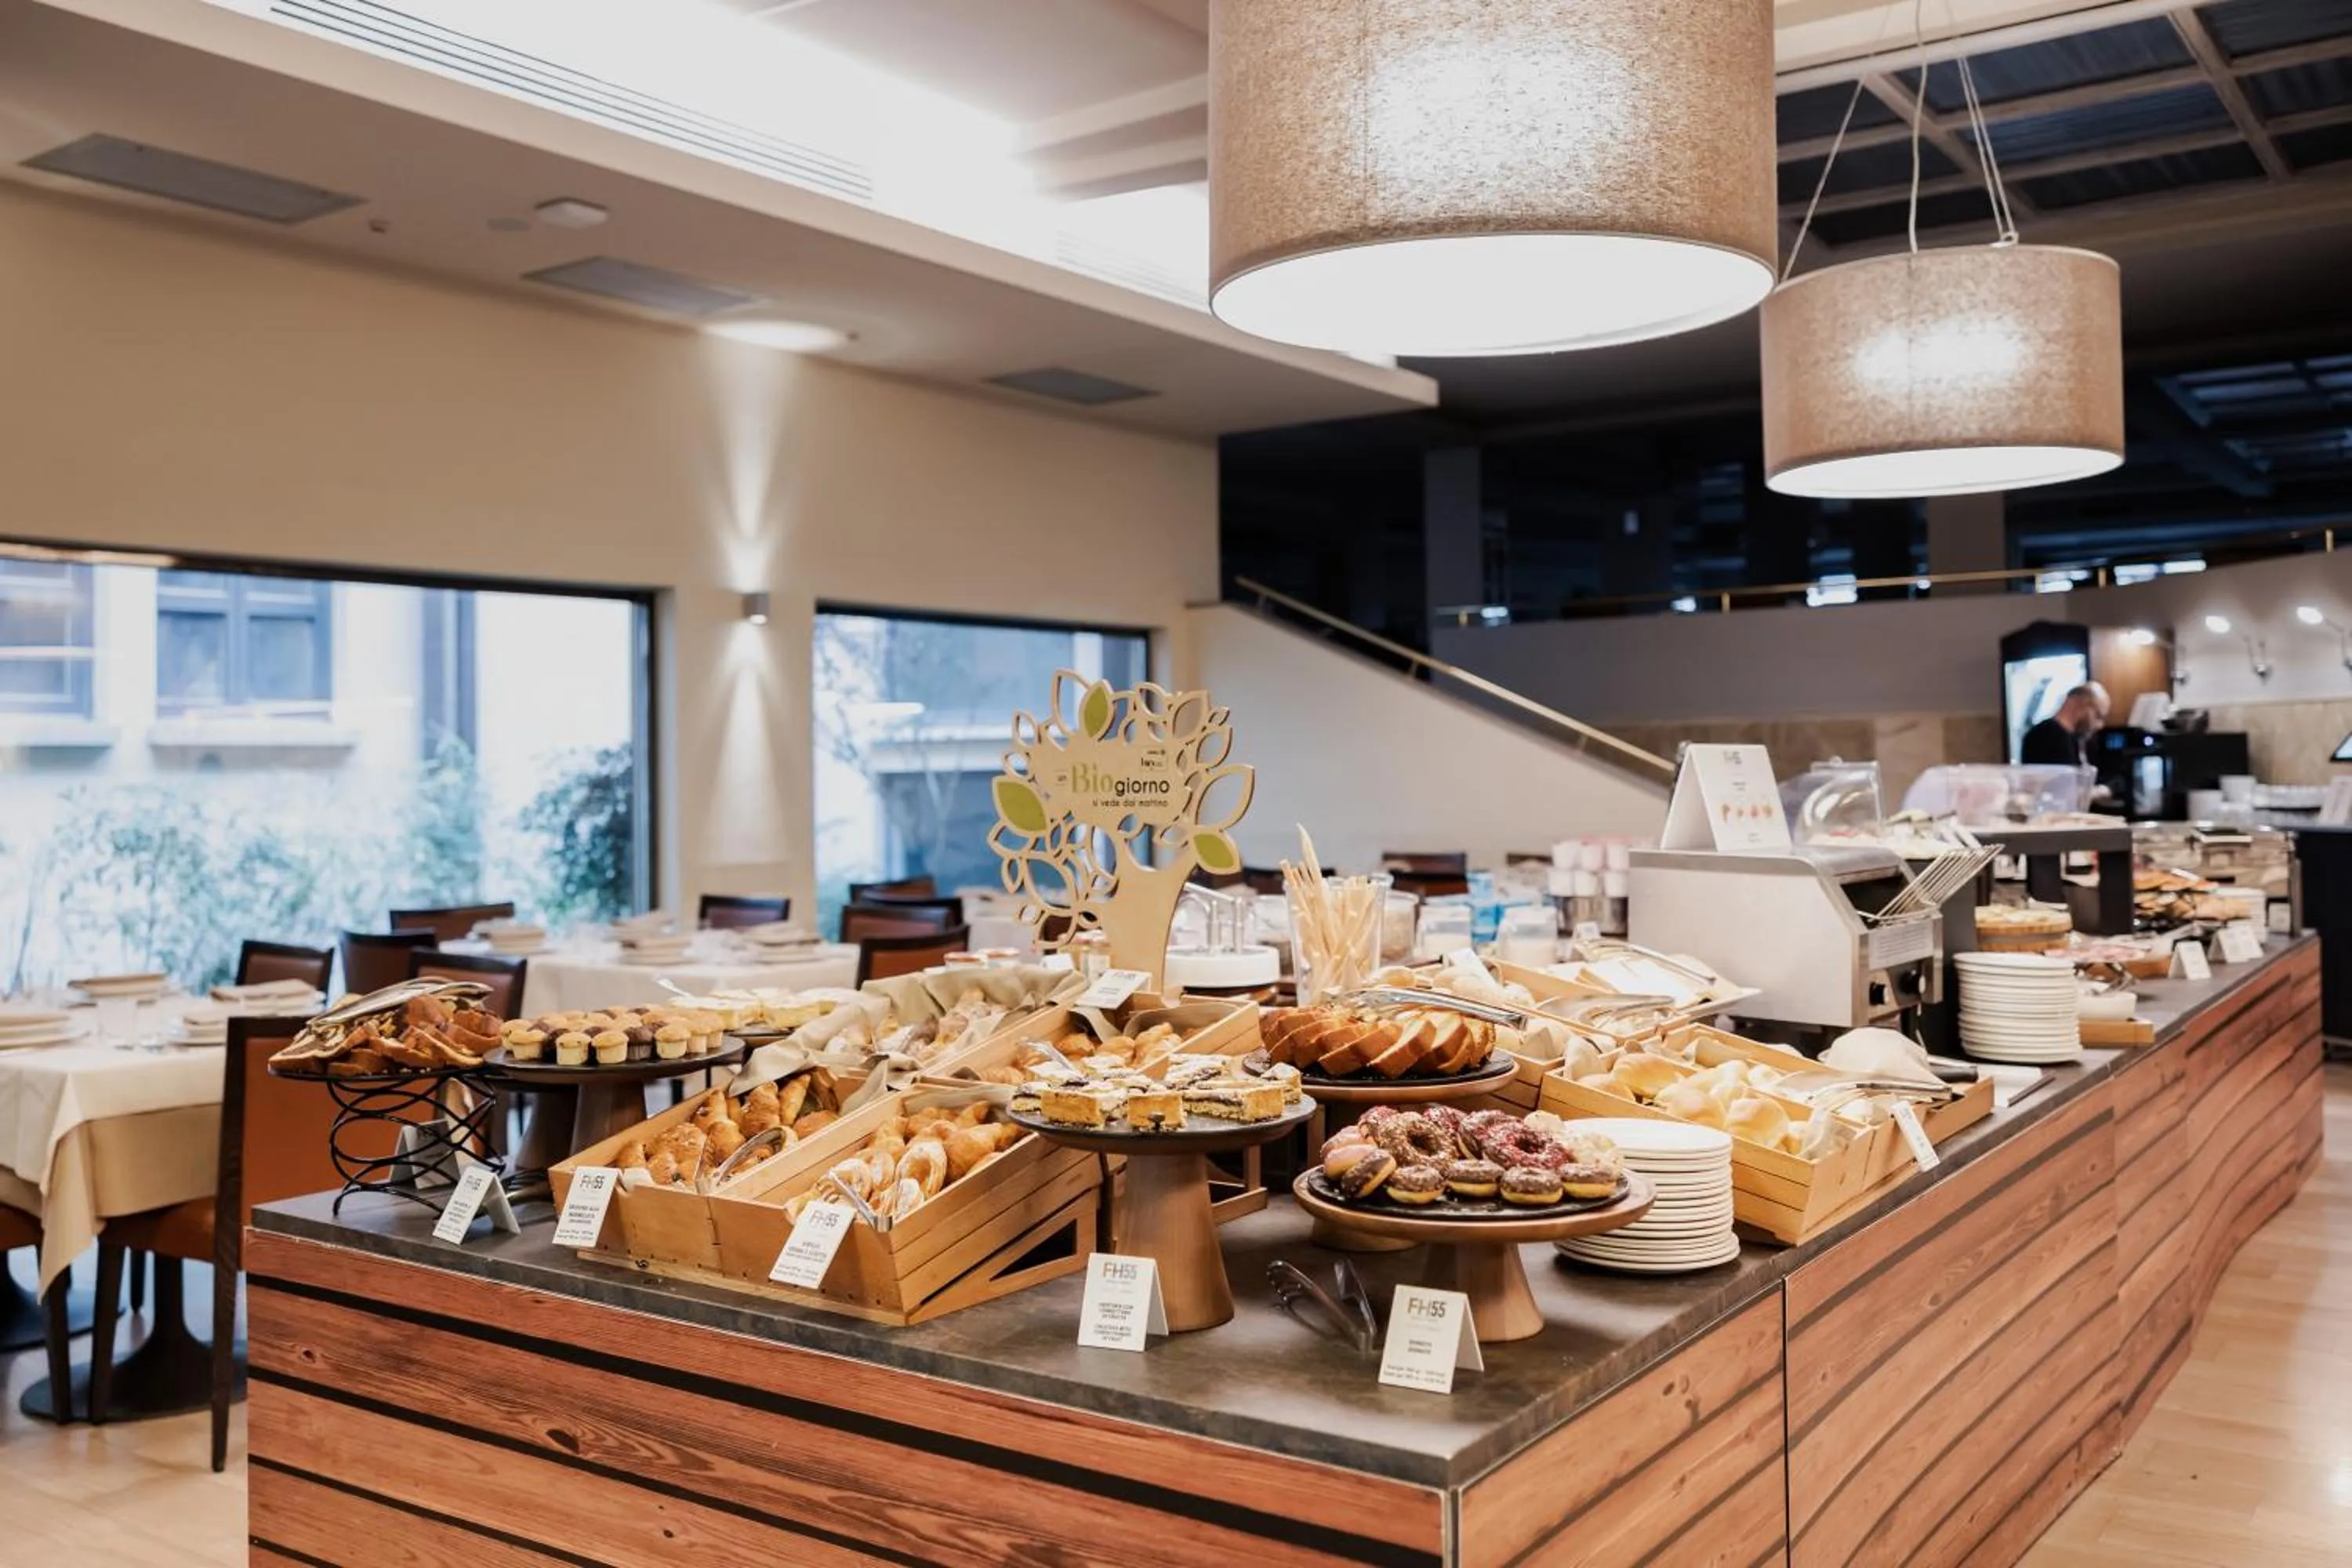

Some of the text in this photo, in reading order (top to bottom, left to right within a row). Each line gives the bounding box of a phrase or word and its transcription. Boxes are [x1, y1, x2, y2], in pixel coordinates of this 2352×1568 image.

[1072, 762, 1171, 797] Biogiorno
[580, 1174, 606, 1189] FH55
[1102, 1261, 1138, 1279] FH55
[1407, 1297, 1448, 1318] FH55
